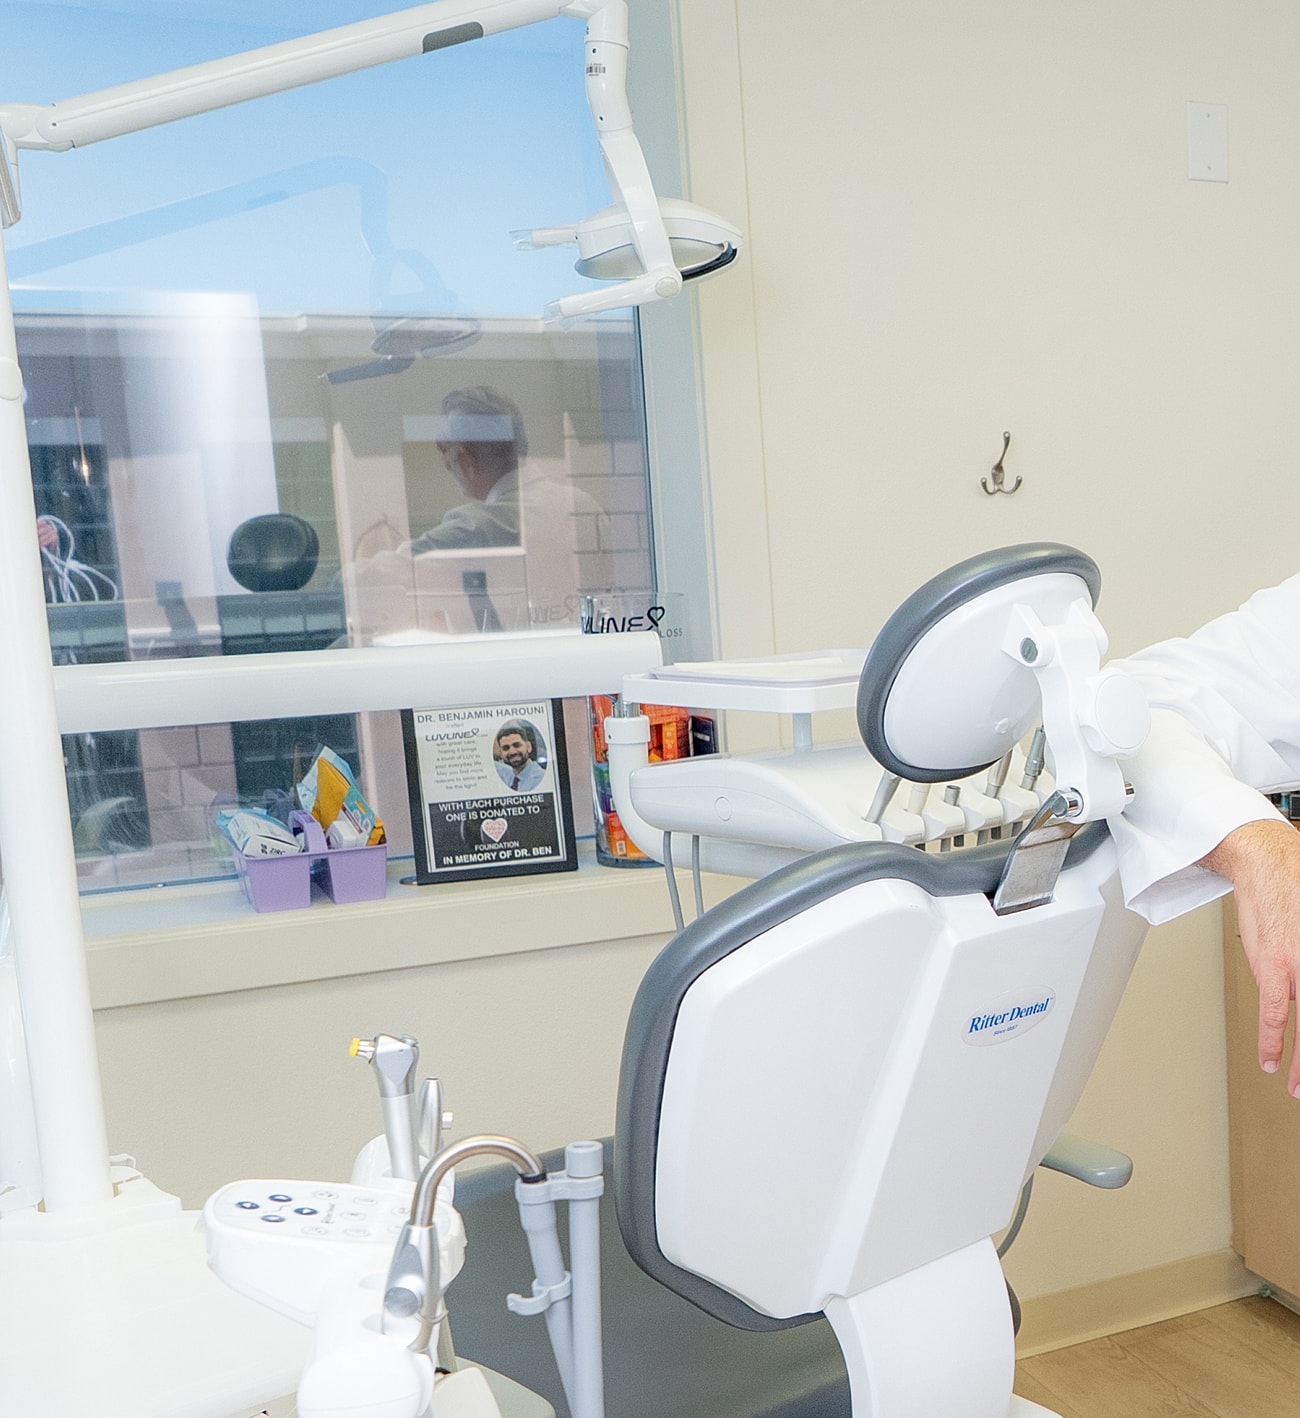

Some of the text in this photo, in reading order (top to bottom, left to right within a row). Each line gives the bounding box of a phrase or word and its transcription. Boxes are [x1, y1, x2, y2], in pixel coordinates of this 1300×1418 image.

[660, 628, 683, 638] LOSS
[417, 706, 544, 724] DR. BENJAMIN HAROUNI
[438, 794, 544, 812] WITH EACH PURCHASE
[446, 806, 540, 822] ONE IS DONATED TO
[443, 846, 552, 864] IN MEMORY OF DR. BEN
[475, 841, 520, 851] FOUNDATION
[968, 998, 1050, 1033] Ritter Dental
